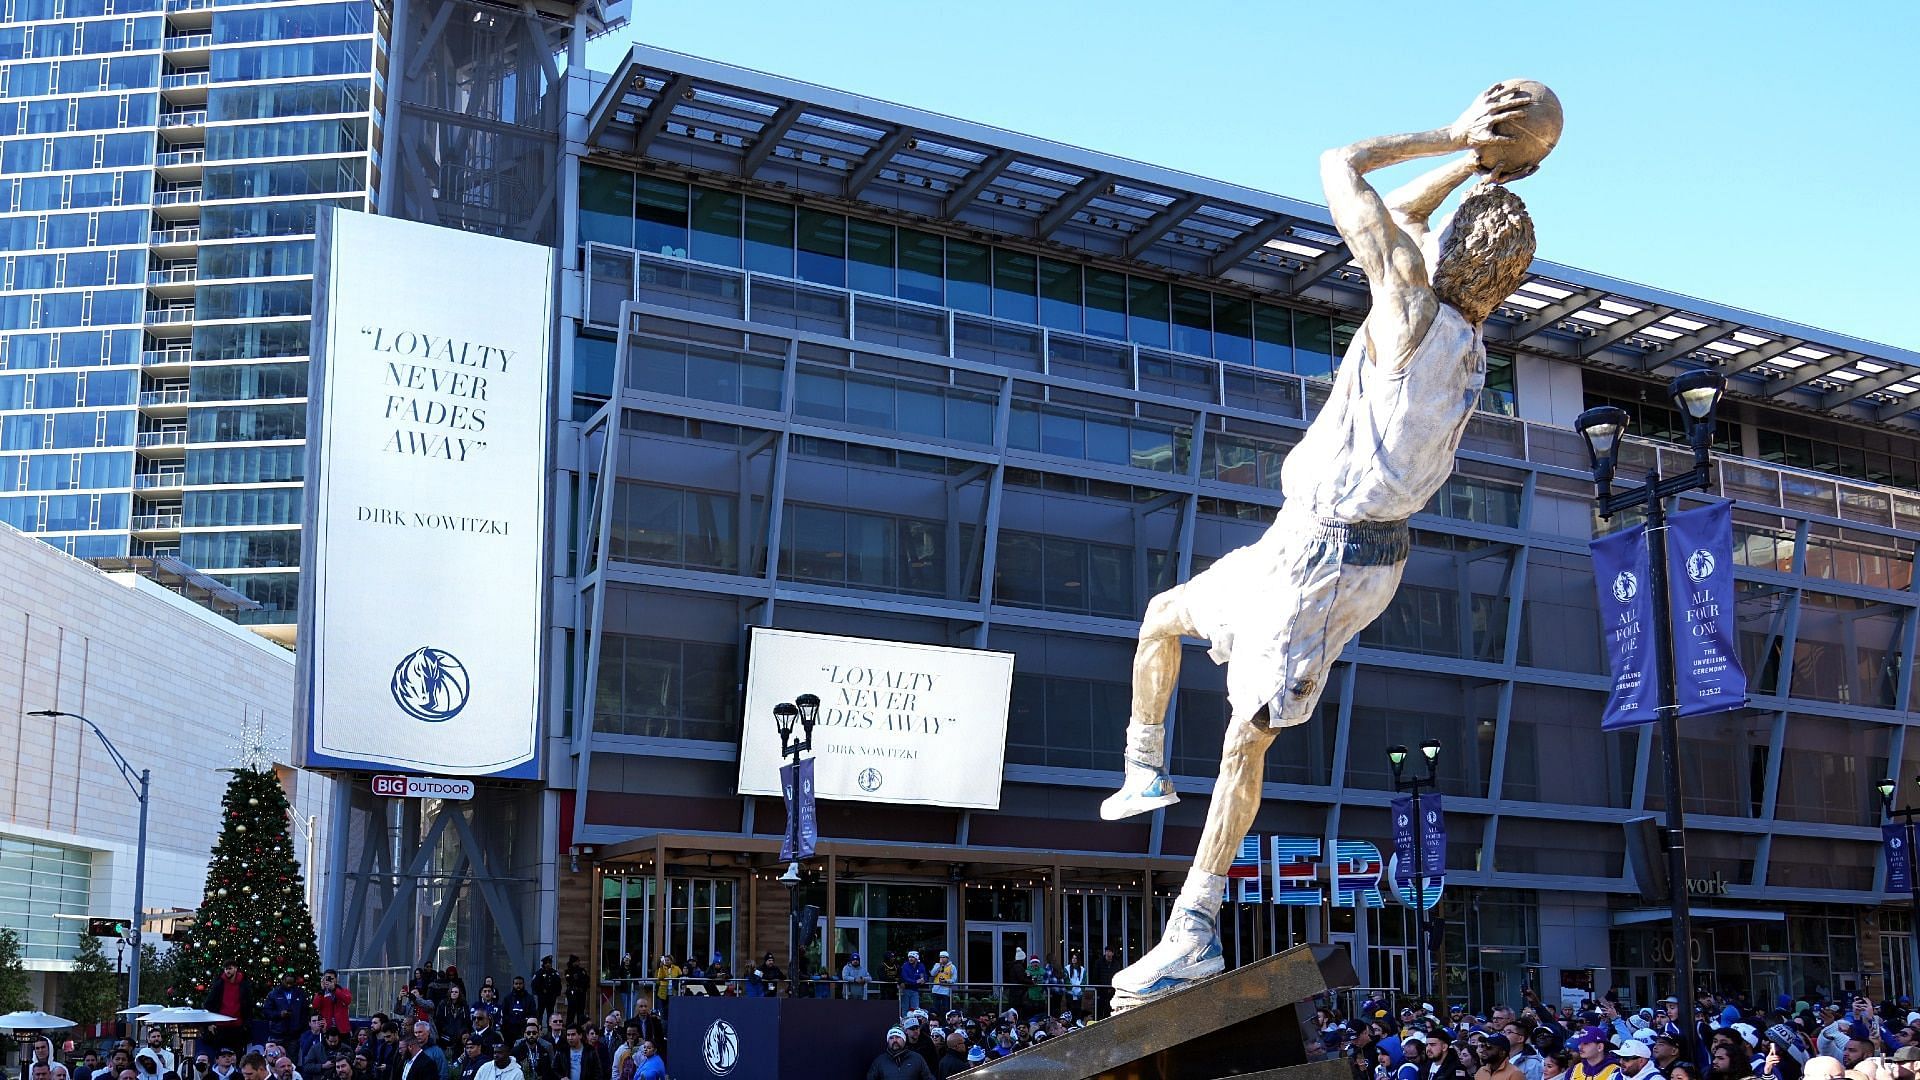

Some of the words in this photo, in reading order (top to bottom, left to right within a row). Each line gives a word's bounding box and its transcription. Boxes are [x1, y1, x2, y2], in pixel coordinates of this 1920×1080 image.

[360, 325, 518, 374] “LOYALTY
[384, 361, 488, 402] NEVER
[383, 394, 487, 433] FADES
[383, 429, 487, 462] AWAY”
[356, 505, 407, 527] DIRK
[413, 513, 511, 536] NOWITZKI
[1691, 589, 1714, 606] ALL
[1618, 609, 1638, 626] ALL
[1685, 603, 1720, 623] FOUR
[1692, 620, 1717, 637] ONE
[1693, 656, 1727, 666] UNVEILING
[1693, 664, 1727, 675] CEREMONY
[821, 664, 942, 692] “LOYALTY
[836, 687, 918, 712] NEVER
[1699, 687, 1721, 697] 12.25.22
[880, 712, 957, 735] AWAY”
[826, 743, 857, 756] DIRK
[859, 745, 919, 761] NOWITZKI
[377, 778, 404, 793] BIG
[408, 782, 469, 795] OUTDOOR
[1650, 937, 1701, 963] 300
